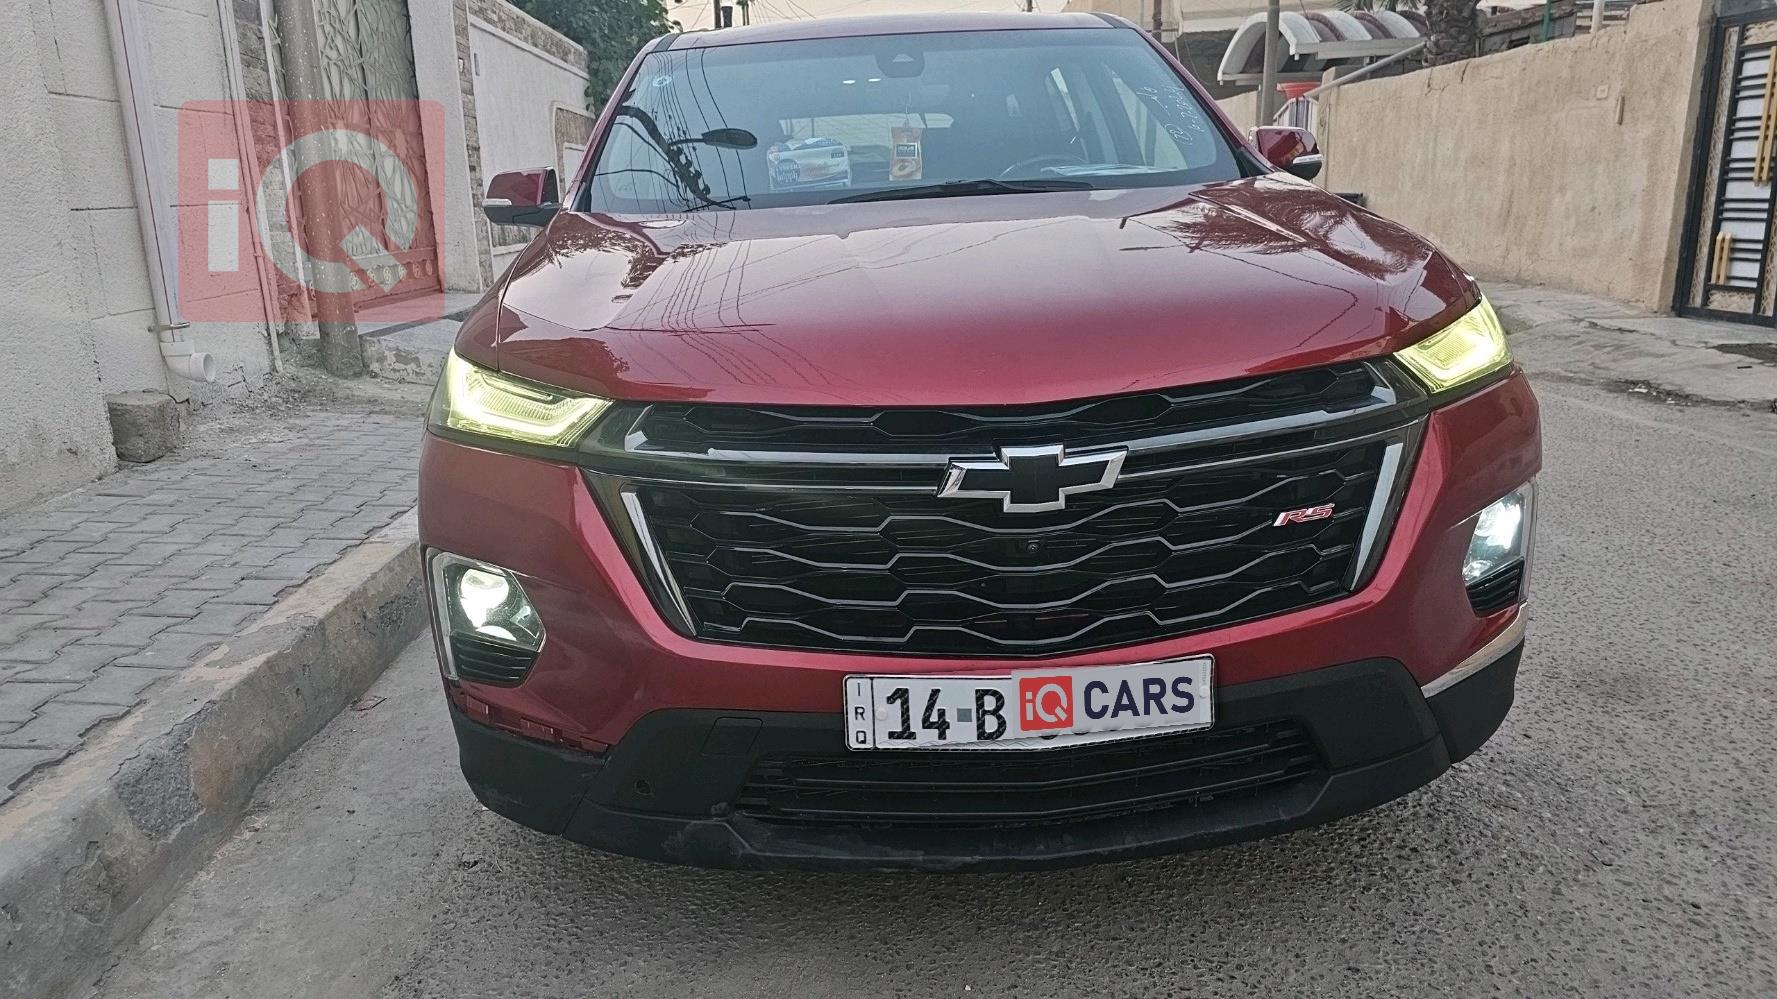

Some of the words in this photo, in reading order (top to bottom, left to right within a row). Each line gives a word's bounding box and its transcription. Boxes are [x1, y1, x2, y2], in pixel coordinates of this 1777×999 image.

[1273, 503, 1335, 526] RS
[885, 687, 951, 741] 14
[975, 687, 1008, 741] B
